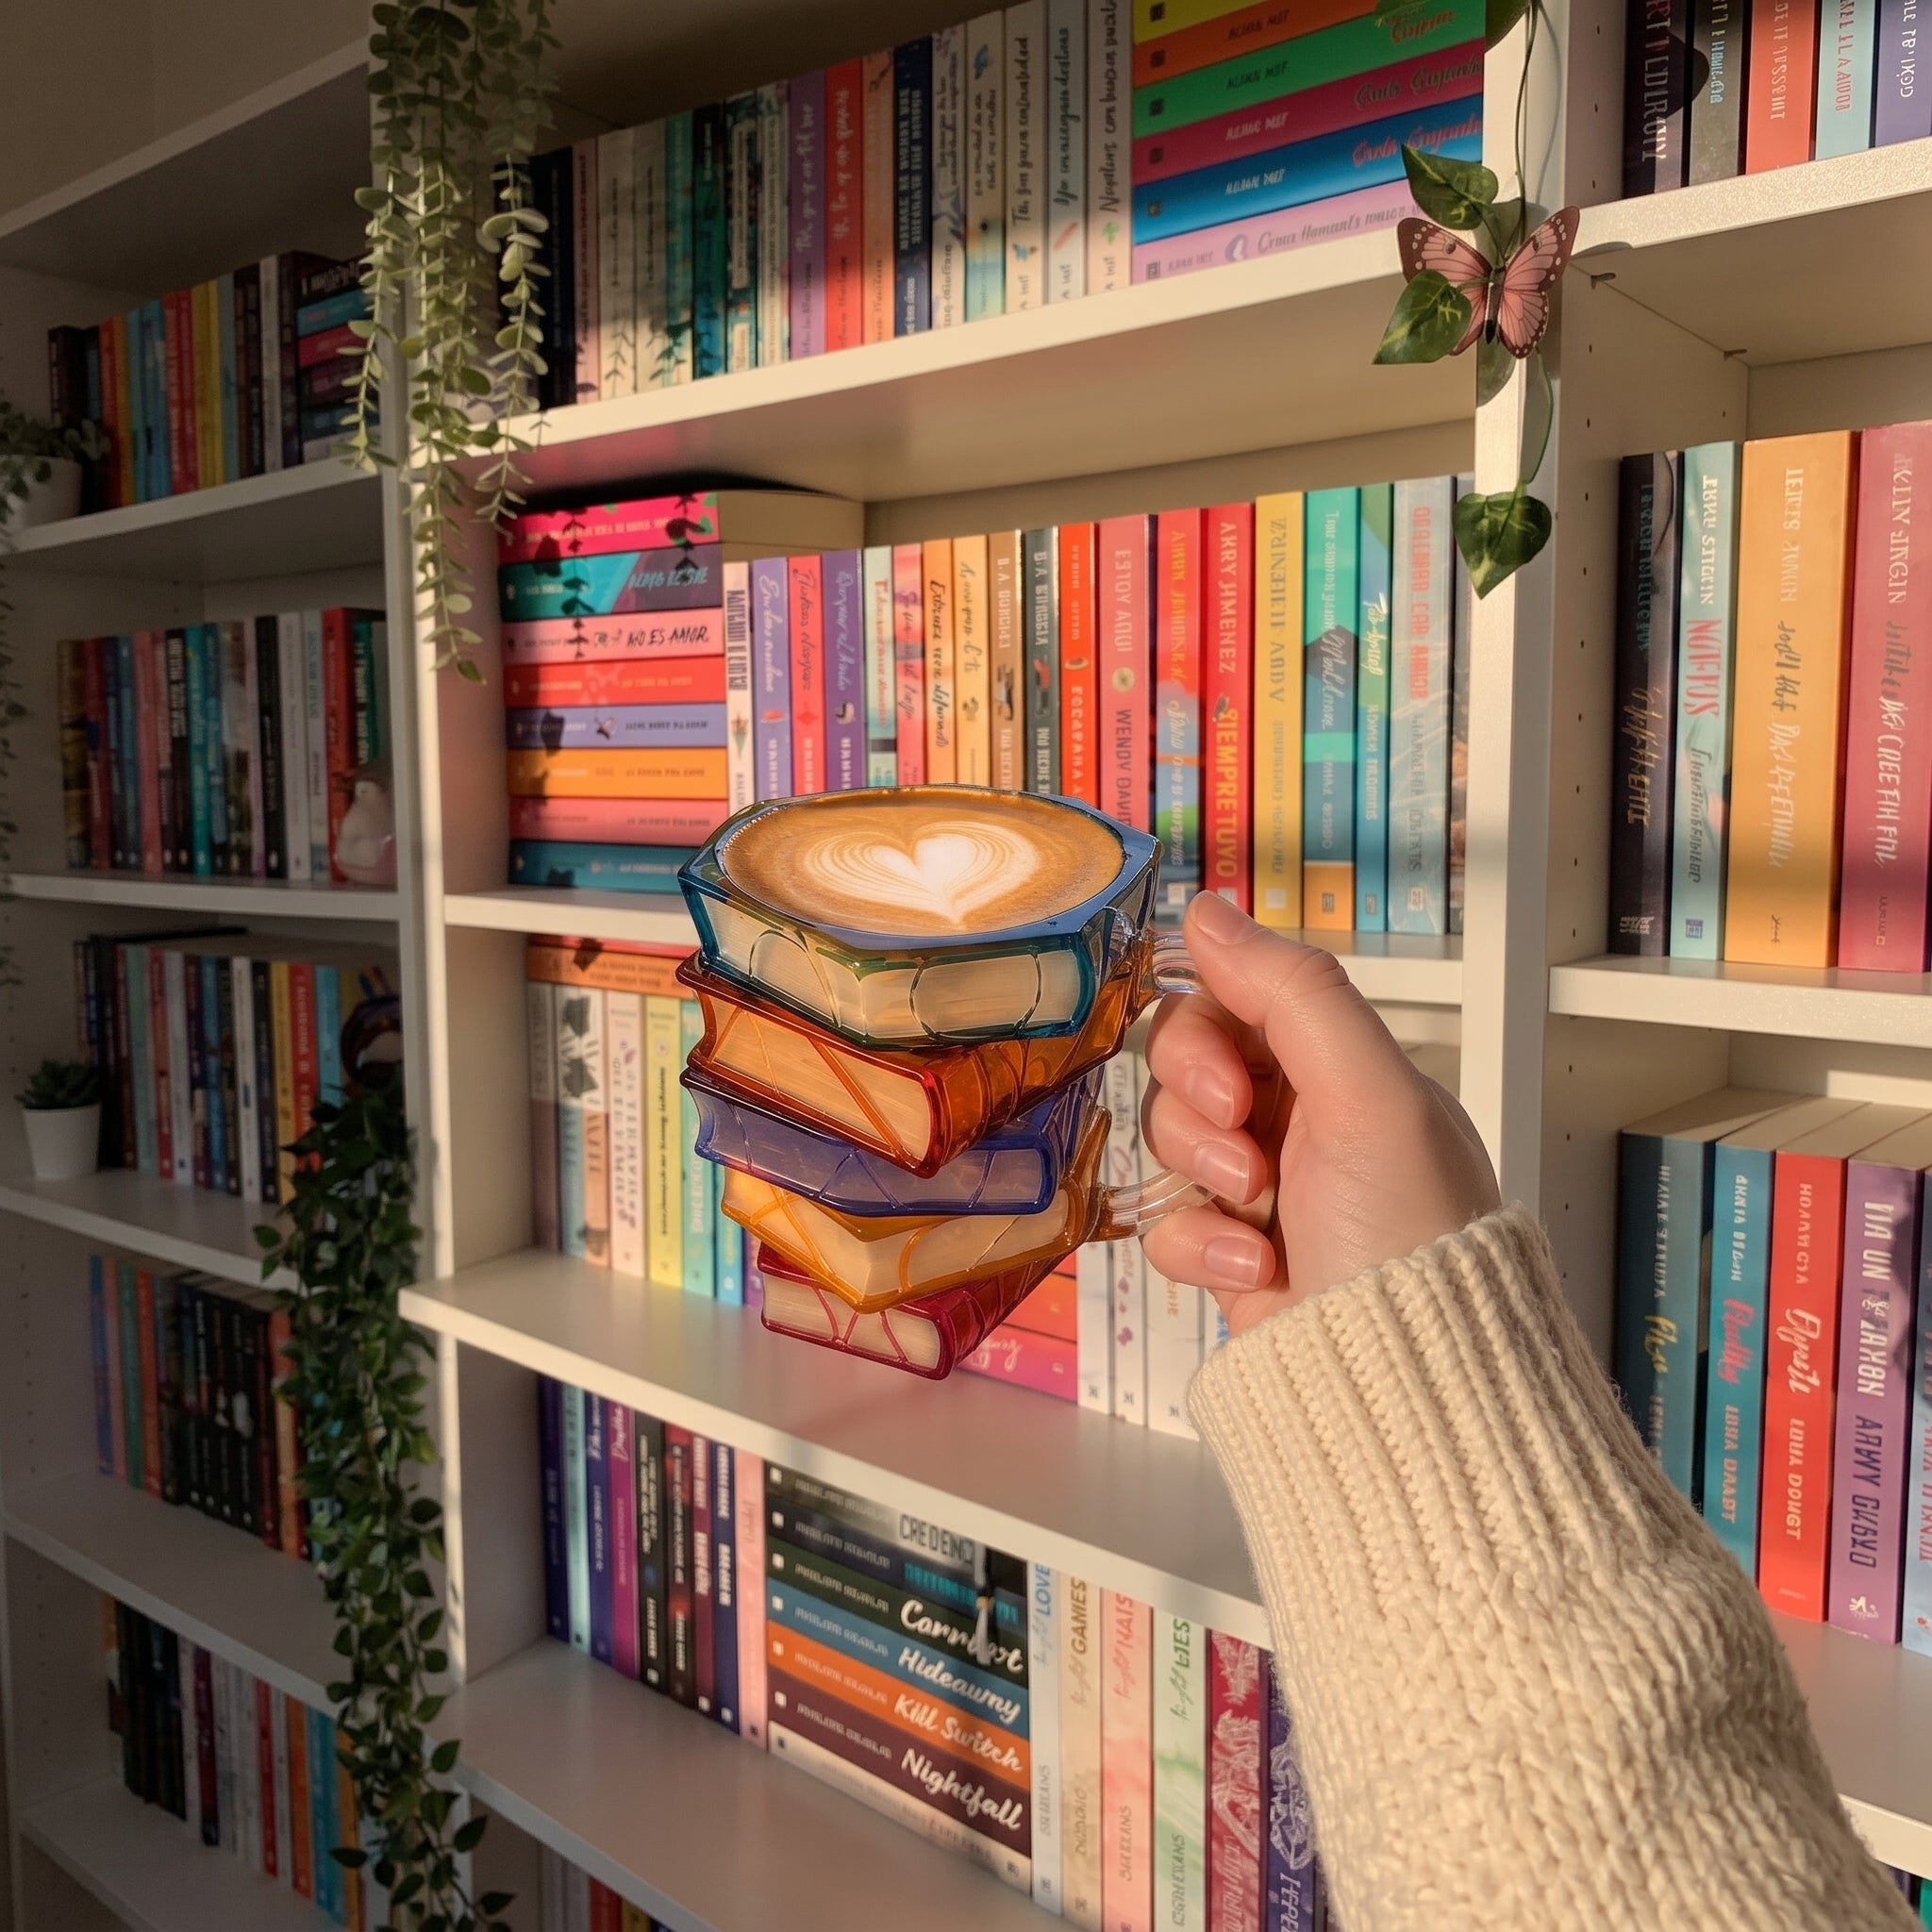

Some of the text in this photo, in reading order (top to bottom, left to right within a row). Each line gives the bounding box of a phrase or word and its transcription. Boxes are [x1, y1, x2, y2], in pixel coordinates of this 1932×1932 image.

[1034, 1564, 1052, 1617] LOVE
[894, 1692, 1024, 1773] Kill Switch
[901, 1748, 1024, 1830] Nightfall
